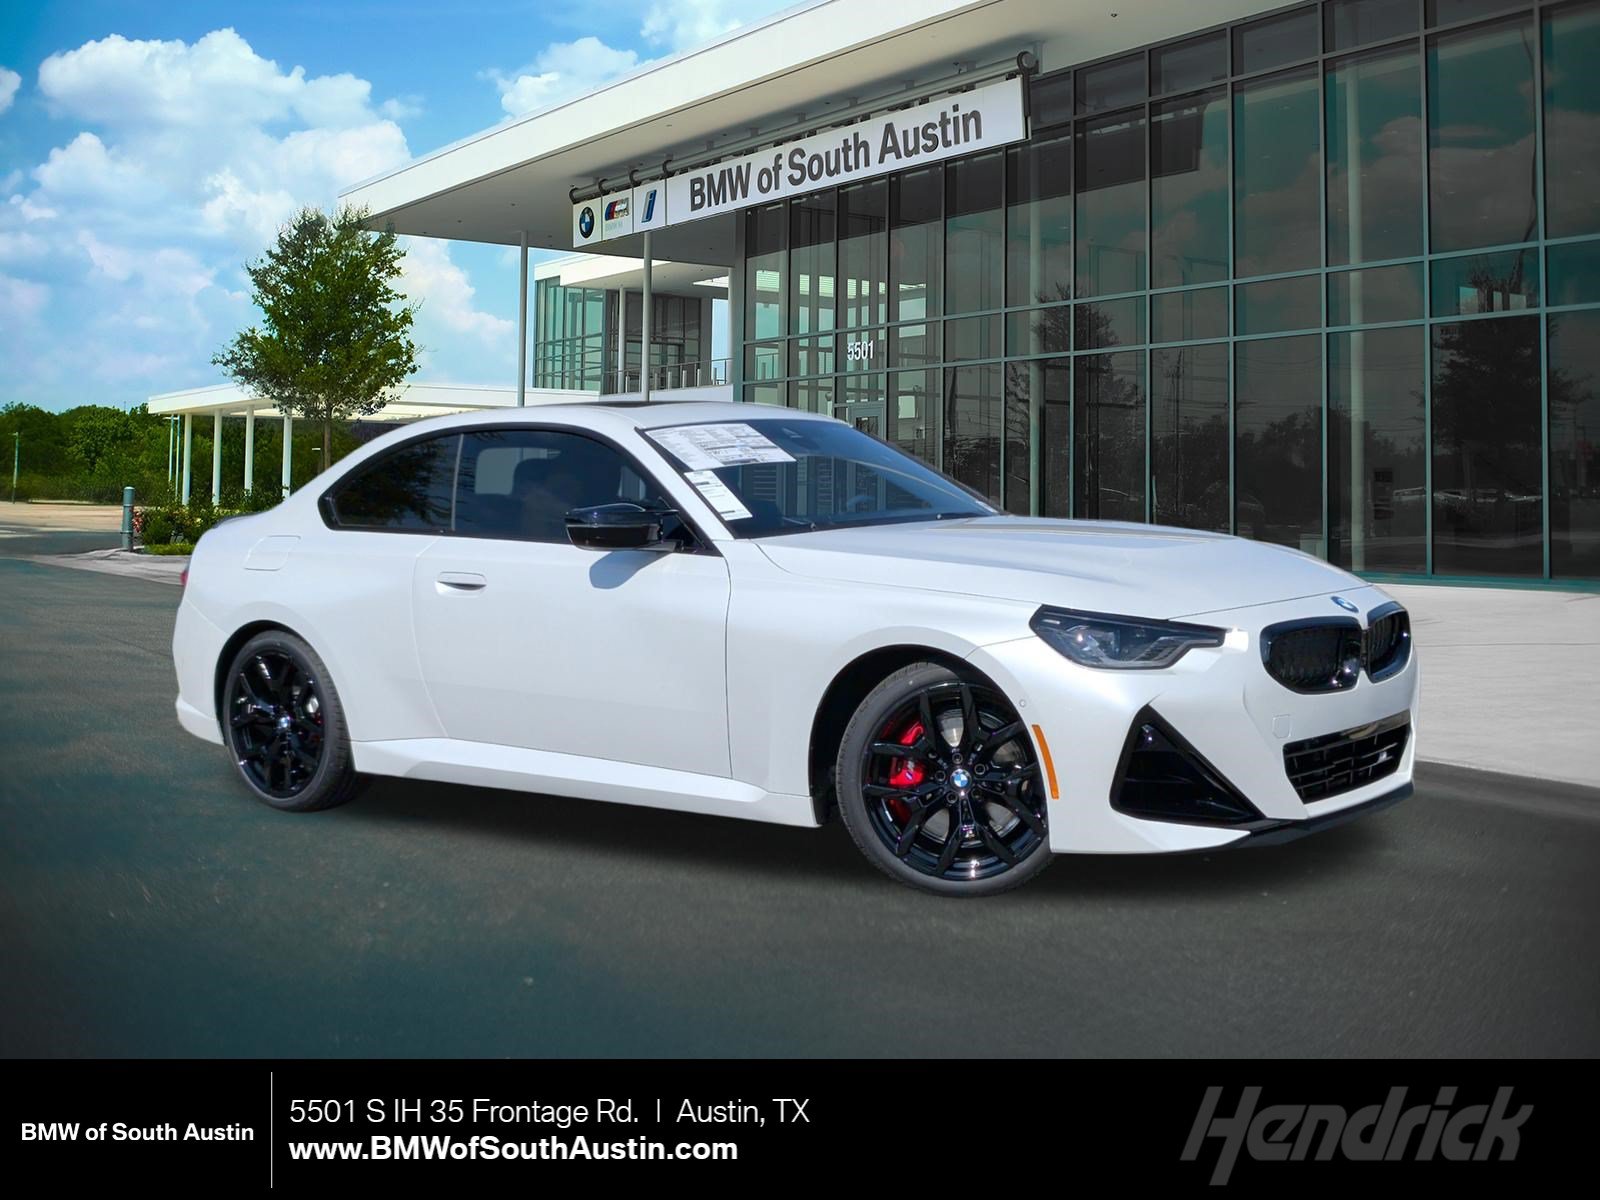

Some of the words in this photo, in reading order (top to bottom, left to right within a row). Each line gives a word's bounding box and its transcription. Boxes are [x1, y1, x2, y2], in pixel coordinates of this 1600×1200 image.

[689, 161, 752, 212] BMW
[757, 153, 783, 194] of
[787, 131, 871, 187] South
[878, 103, 983, 165] Austin
[847, 340, 874, 361] 5501
